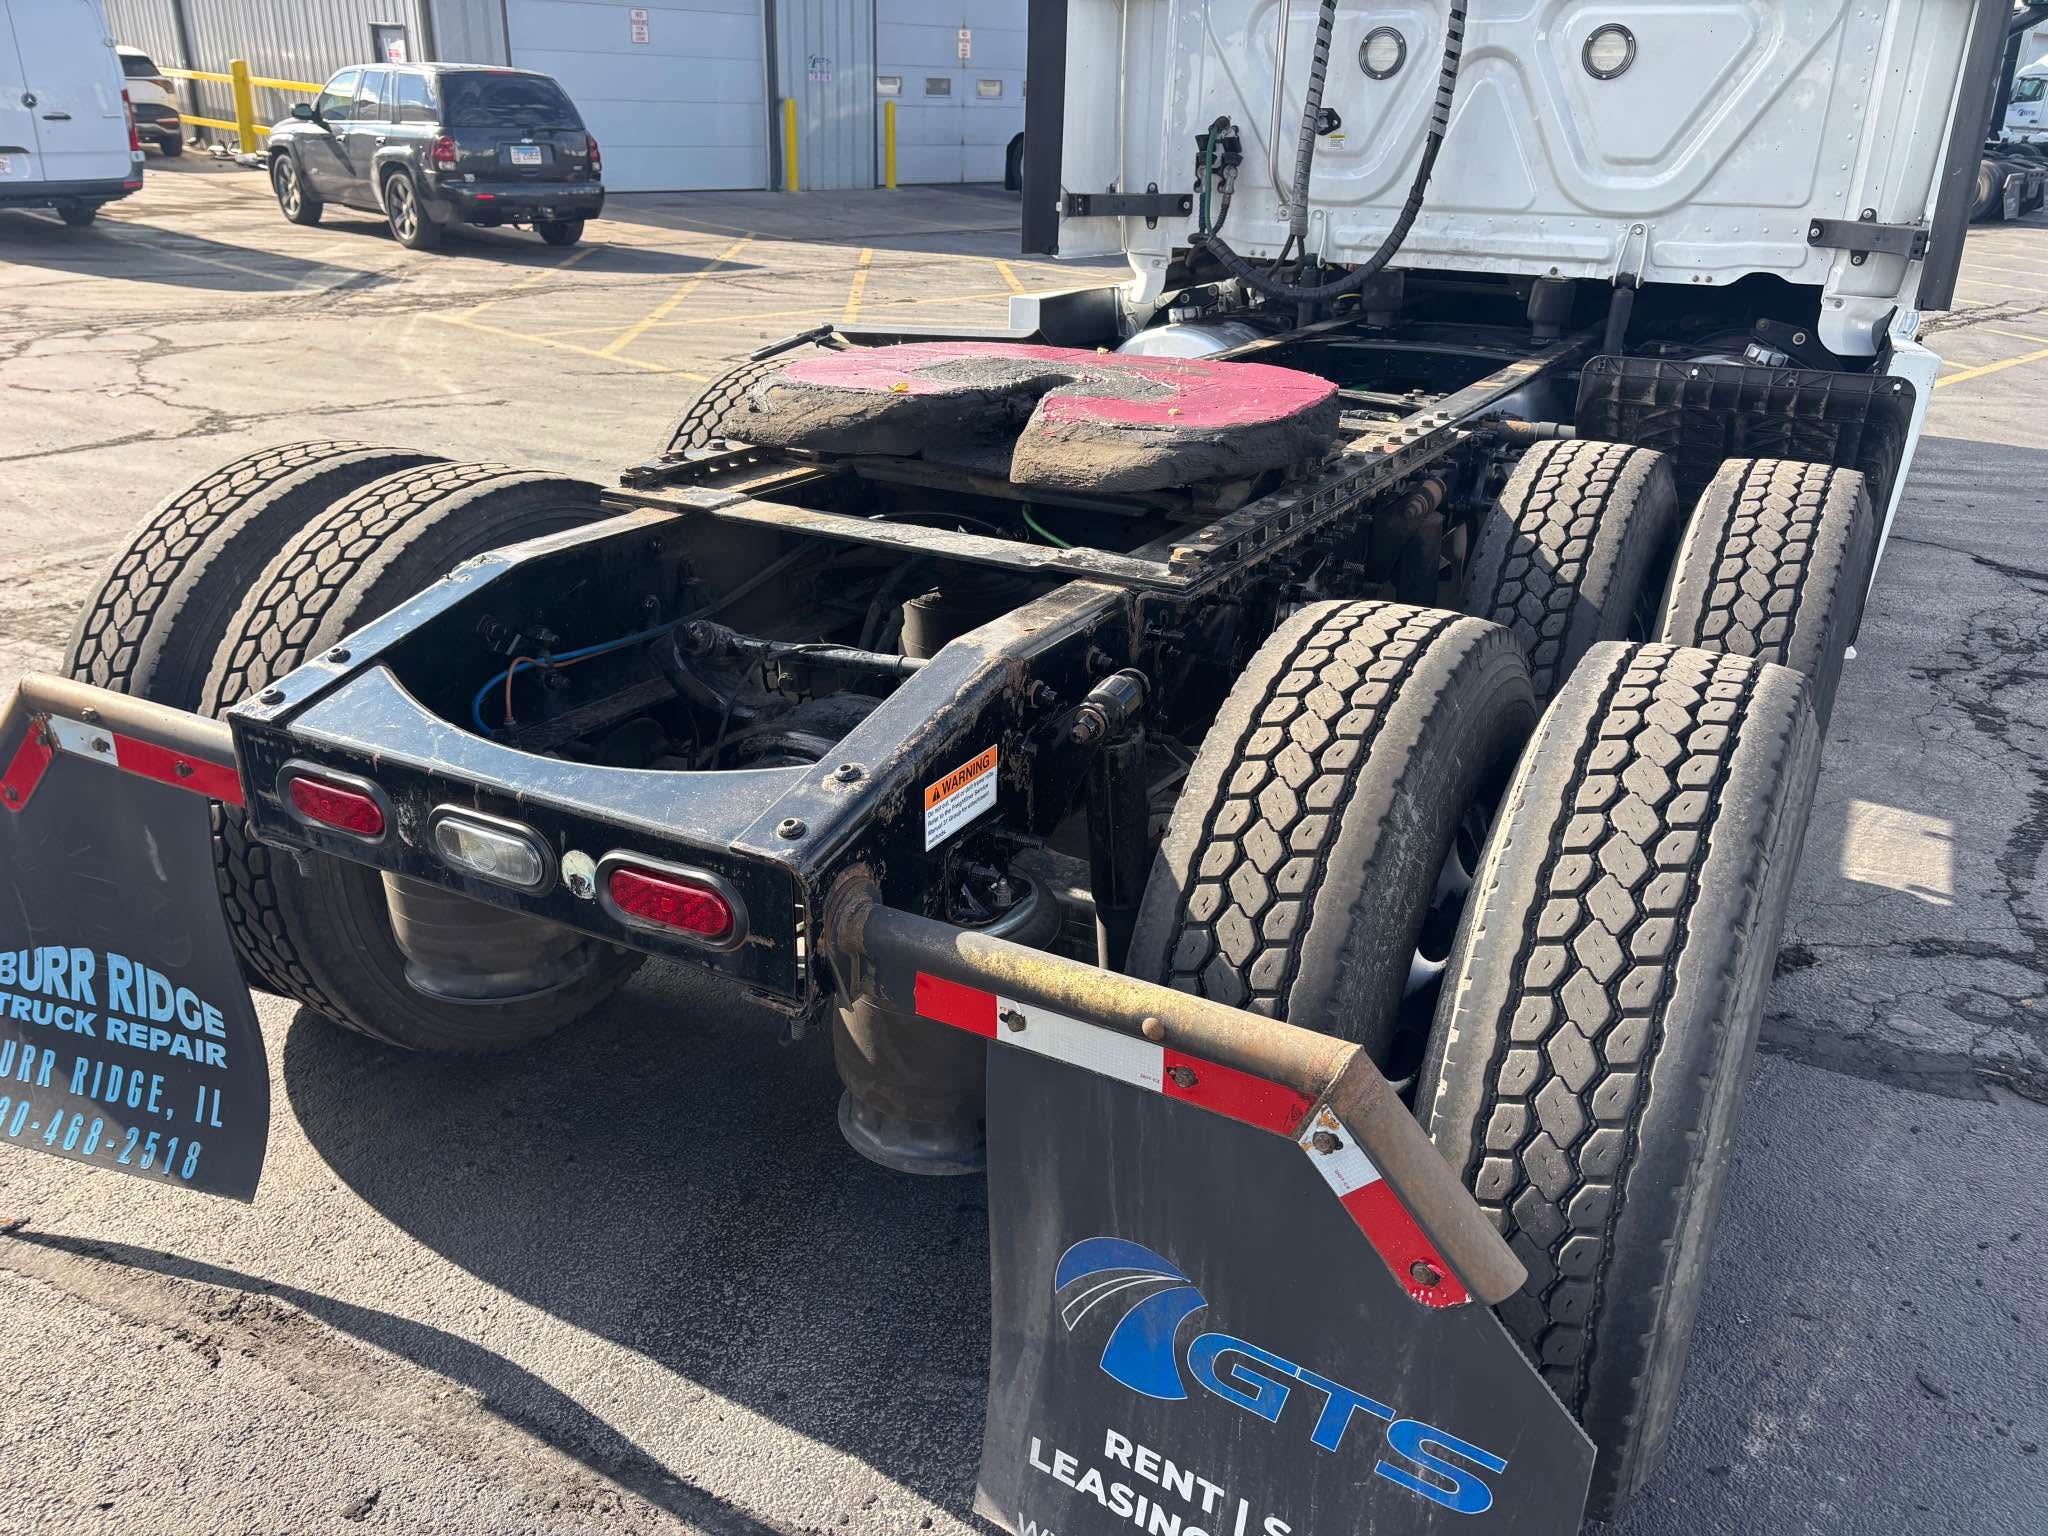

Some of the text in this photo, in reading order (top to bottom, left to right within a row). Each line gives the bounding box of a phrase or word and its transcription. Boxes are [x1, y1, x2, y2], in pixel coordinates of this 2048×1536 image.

[942, 755, 989, 794] WARNING
[0, 946, 226, 1038] BURR RIDGE
[0, 991, 228, 1069] TRUCK REPAIR
[0, 1040, 223, 1128] URR RIDGE, IL
[0, 1096, 201, 1180] 30-468-2518
[1187, 1332, 1508, 1514] GTS
[1104, 1428, 1225, 1515] RENT
